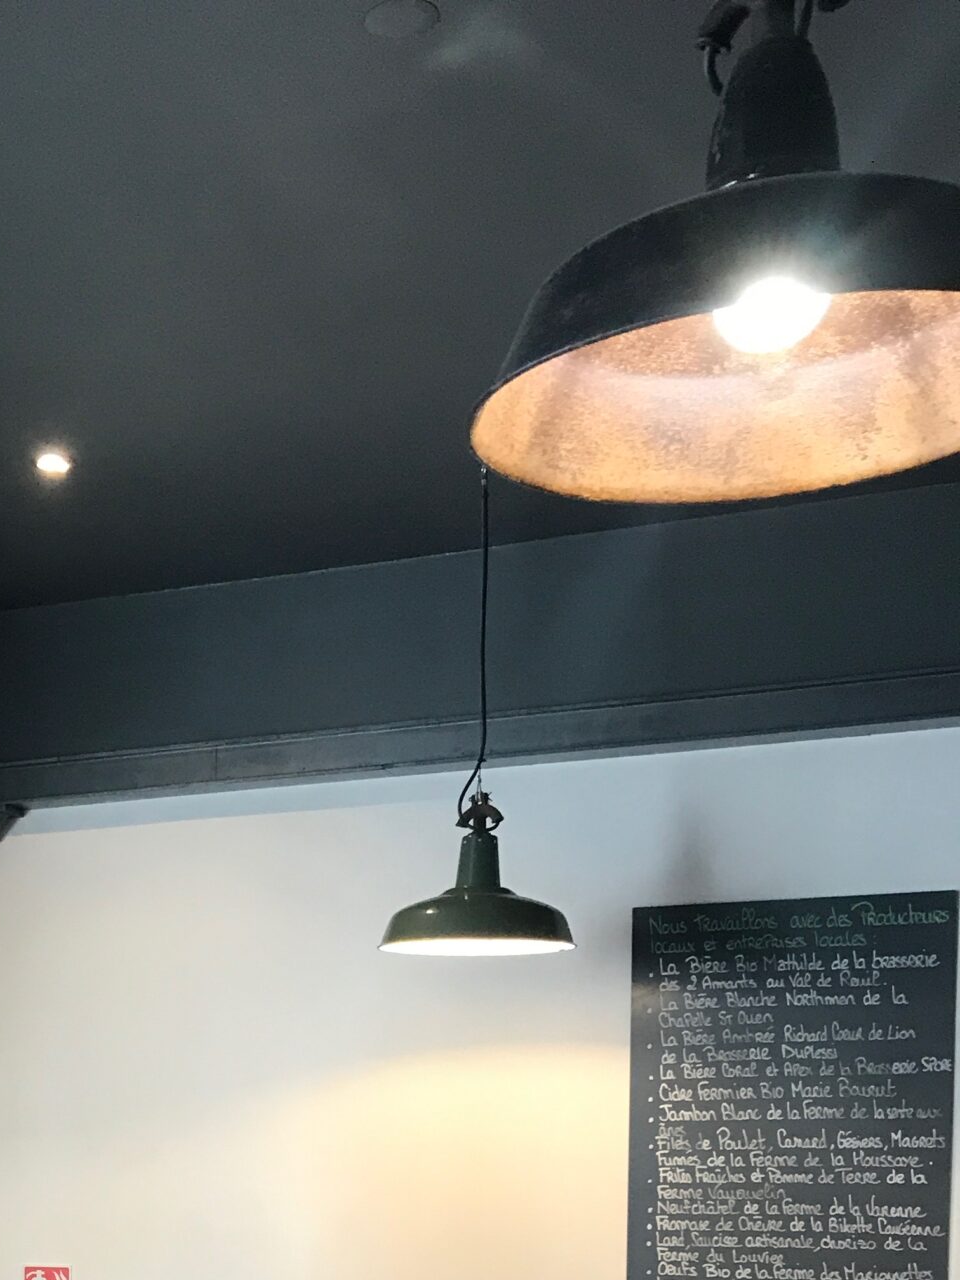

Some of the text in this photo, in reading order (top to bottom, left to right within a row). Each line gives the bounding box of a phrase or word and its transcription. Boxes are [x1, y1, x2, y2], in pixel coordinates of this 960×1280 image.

[649, 917, 687, 935] Nous
[790, 917, 821, 929] avec
[827, 907, 853, 927] des
[651, 939, 694, 954] locaux
[704, 939, 718, 950] et
[659, 958, 679, 976] La
[685, 955, 729, 973] Bière
[735, 954, 757, 972] Bio
[763, 952, 825, 971] Mathilde
[831, 952, 851, 971] de
[853, 950, 866, 970] la
[686, 977, 698, 991] 2
[766, 976, 785, 988] au
[789, 974, 811, 989] Val
[816, 972, 832, 988] de
[660, 997, 679, 1011] La
[683, 993, 721, 1009] Bière
[726, 992, 778, 1007] Blanche
[863, 990, 881, 1005] de
[892, 985, 909, 1005] la
[737, 1011, 774, 1023] Ouen
[661, 1030, 678, 1047] La
[681, 1029, 716, 1045] Bière
[784, 1026, 827, 1043] Richard
[869, 1026, 886, 1041] de
[888, 1026, 916, 1040] Lion
[661, 1051, 676, 1065] de
[683, 1049, 701, 1063] la
[659, 1064, 676, 1081] La
[680, 1061, 716, 1079] Bière
[766, 1060, 780, 1077] et
[819, 1059, 834, 1076] de
[659, 1081, 833, 1102] Cidre Fermier Bio Marie
[659, 1105, 716, 1123] Jambon
[721, 1103, 762, 1121] Blanc
[767, 1103, 785, 1120] de
[787, 1101, 801, 1119] la
[851, 1102, 868, 1119] de
[873, 1099, 886, 1119] la
[696, 1131, 711, 1150] de
[707, 1152, 726, 1167] de
[730, 1152, 745, 1167] la
[803, 1152, 823, 1167] de
[831, 1152, 847, 1167] la
[750, 1165, 766, 1183] et
[767, 1167, 814, 1184] Pomme
[817, 1166, 835, 1184] de
[834, 1167, 881, 1184] Terre
[886, 1166, 905, 1184] de
[910, 1166, 928, 1184] la
[657, 1185, 704, 1201] Ferme
[744, 1202, 760, 1216] de
[764, 1202, 780, 1216] la
[829, 1196, 846, 1215] de
[848, 1195, 862, 1218] la
[715, 1216, 733, 1231] de
[790, 1217, 808, 1233] de
[812, 1217, 824, 1232] la
[883, 1235, 903, 1251] de
[707, 1250, 725, 1264] du
[704, 1264, 731, 1278] Bio
[735, 1265, 752, 1279] de
[754, 1265, 771, 1280] la
